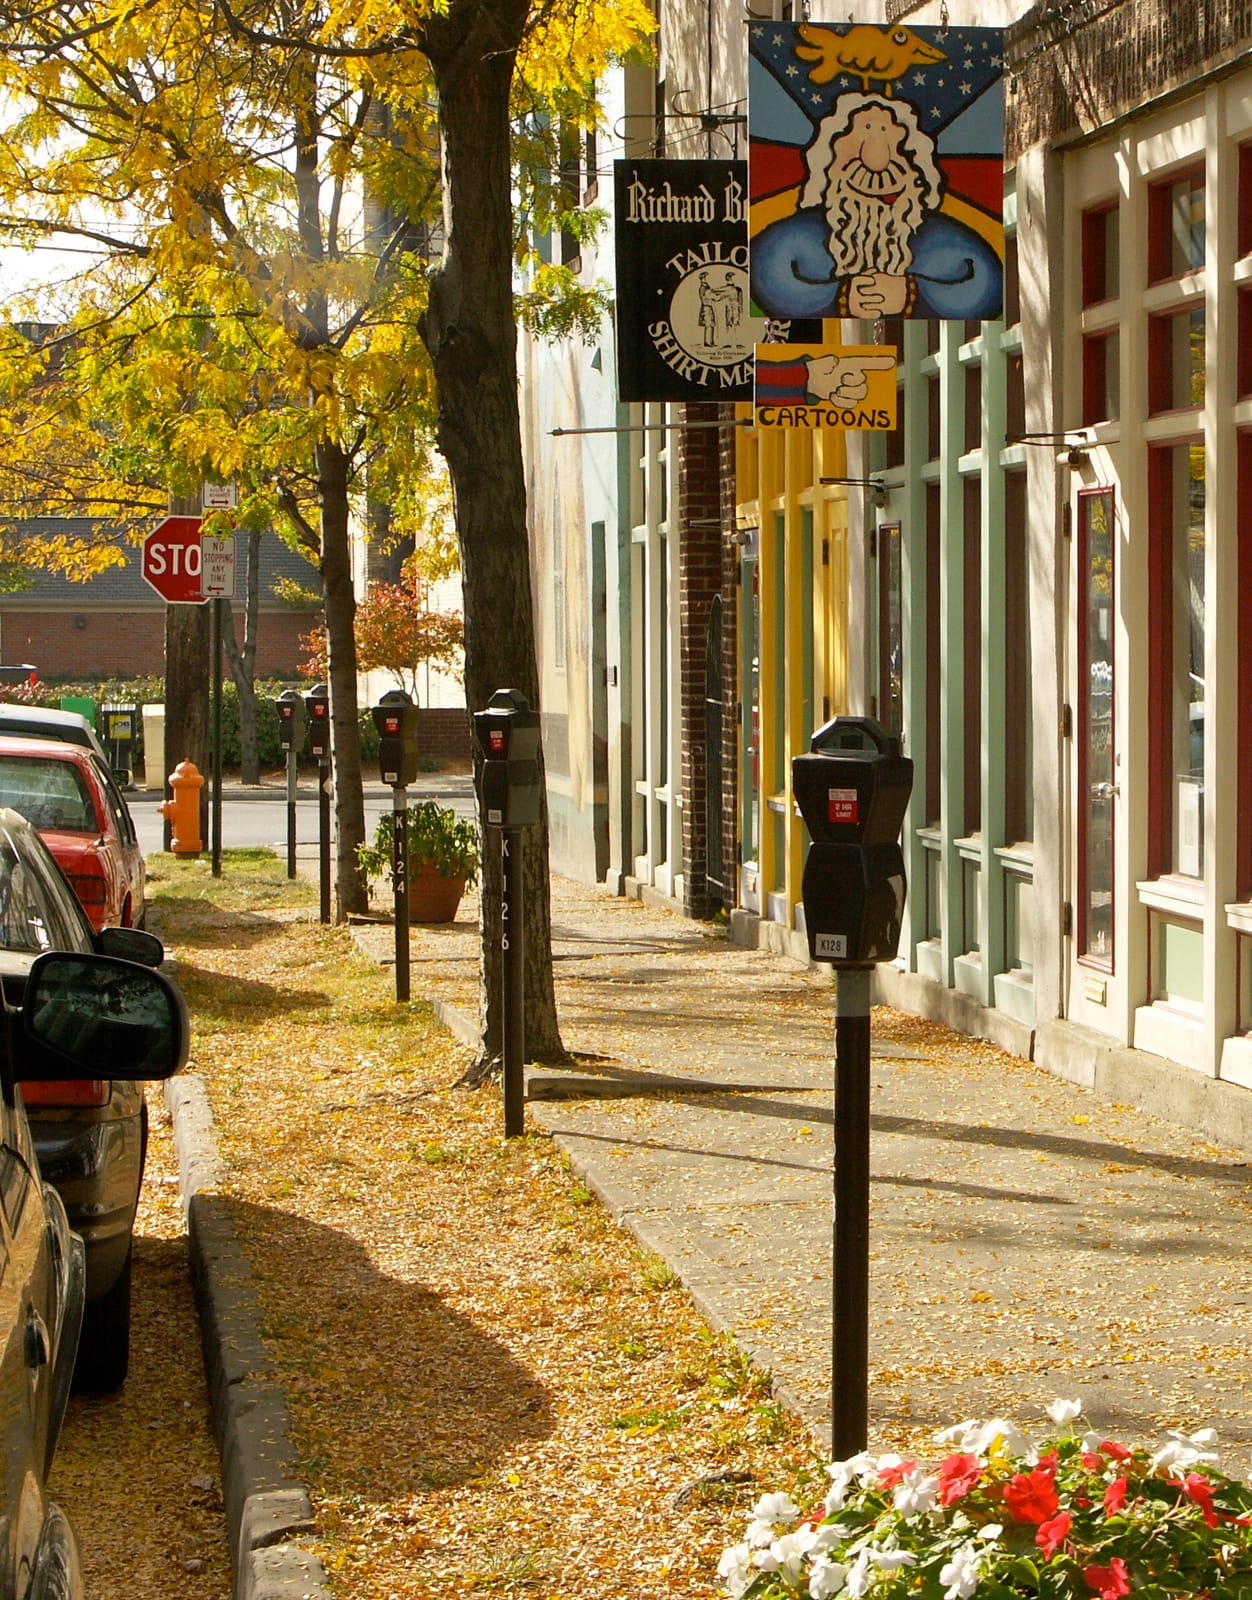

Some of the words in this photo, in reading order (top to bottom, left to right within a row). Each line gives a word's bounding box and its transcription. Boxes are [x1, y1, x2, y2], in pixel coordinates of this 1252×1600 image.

[625, 169, 716, 223] Richard
[665, 241, 748, 278] TAILO
[759, 407, 891, 428] CARTOONS
[212, 541, 225, 551] NO
[148, 543, 202, 576] STO
[203, 553, 233, 563] STOPPING
[212, 565, 224, 573] ANY
[211, 574, 226, 582] TIME
[821, 939, 842, 952] K128
